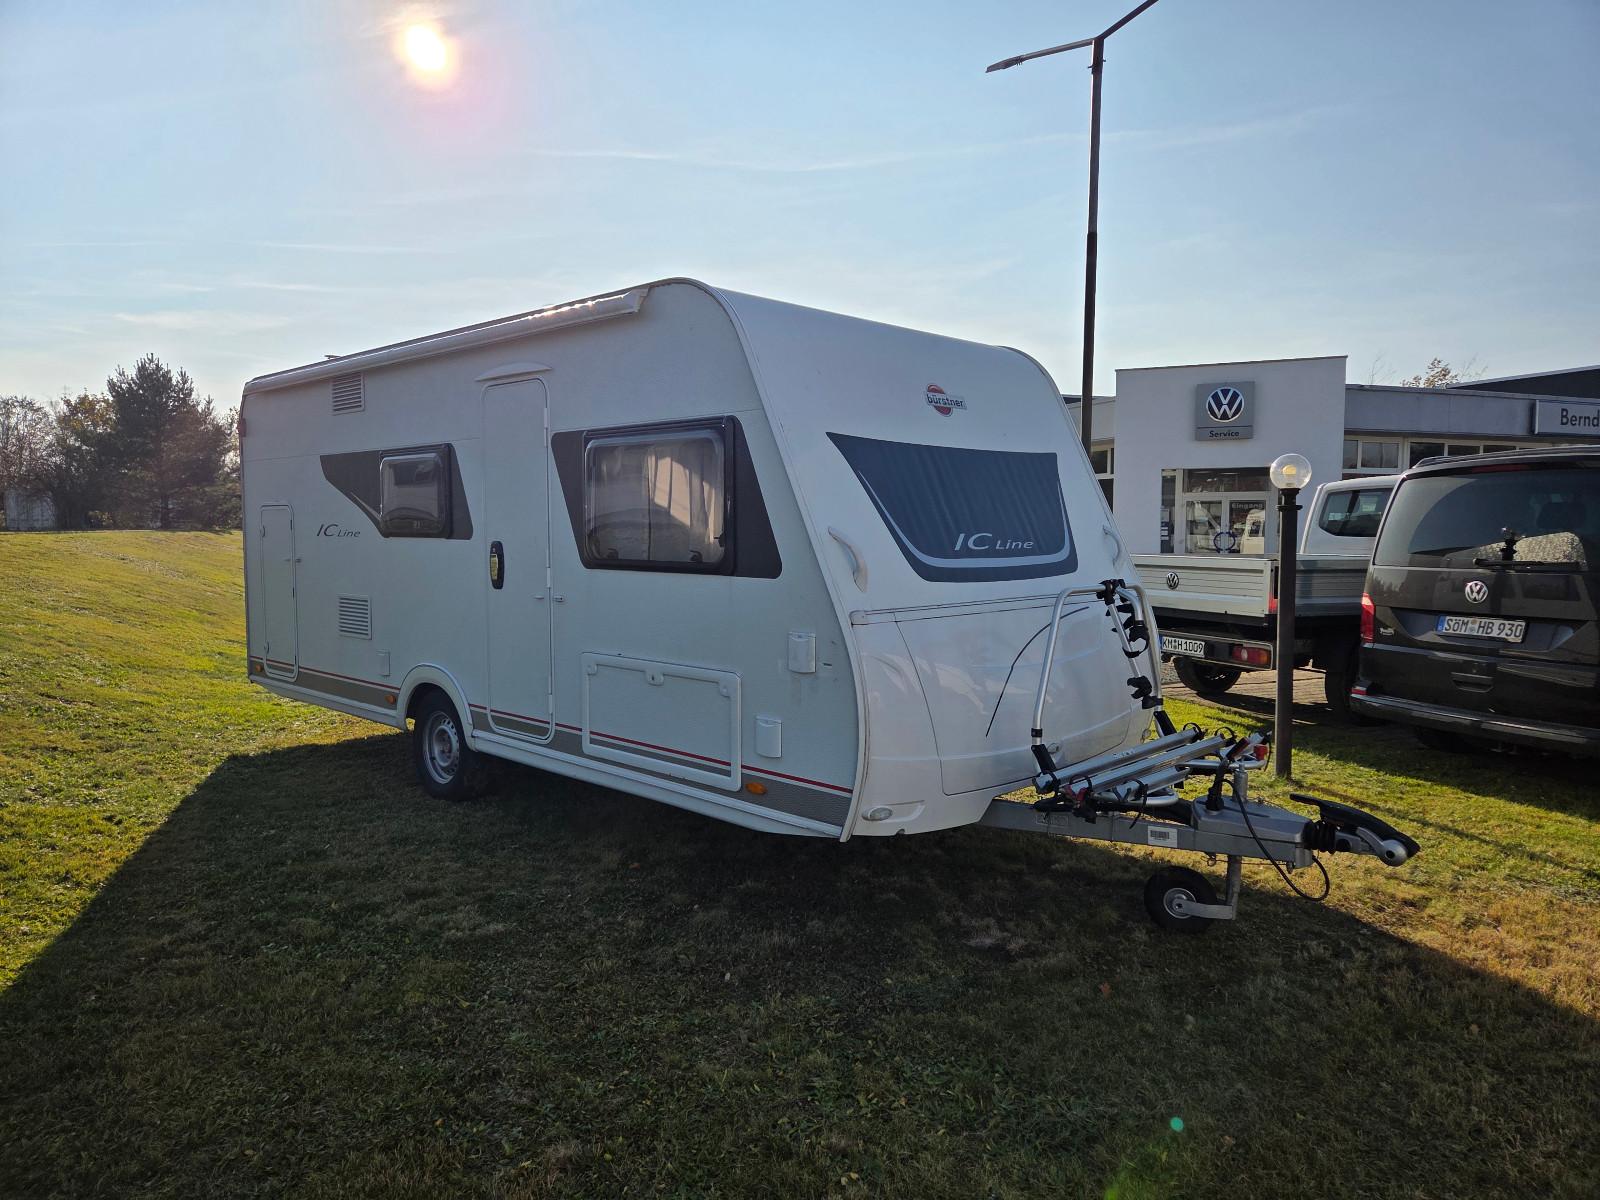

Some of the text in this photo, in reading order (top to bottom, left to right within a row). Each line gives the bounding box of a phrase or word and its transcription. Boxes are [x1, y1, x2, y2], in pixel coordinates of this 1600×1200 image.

[1560, 407, 1600, 427] Bernd
[1208, 430, 1240, 438] Service
[337, 529, 361, 538] Line
[954, 532, 1034, 551] IC Line
[1476, 620, 1495, 635] HB
[1497, 623, 1524, 638] 930
